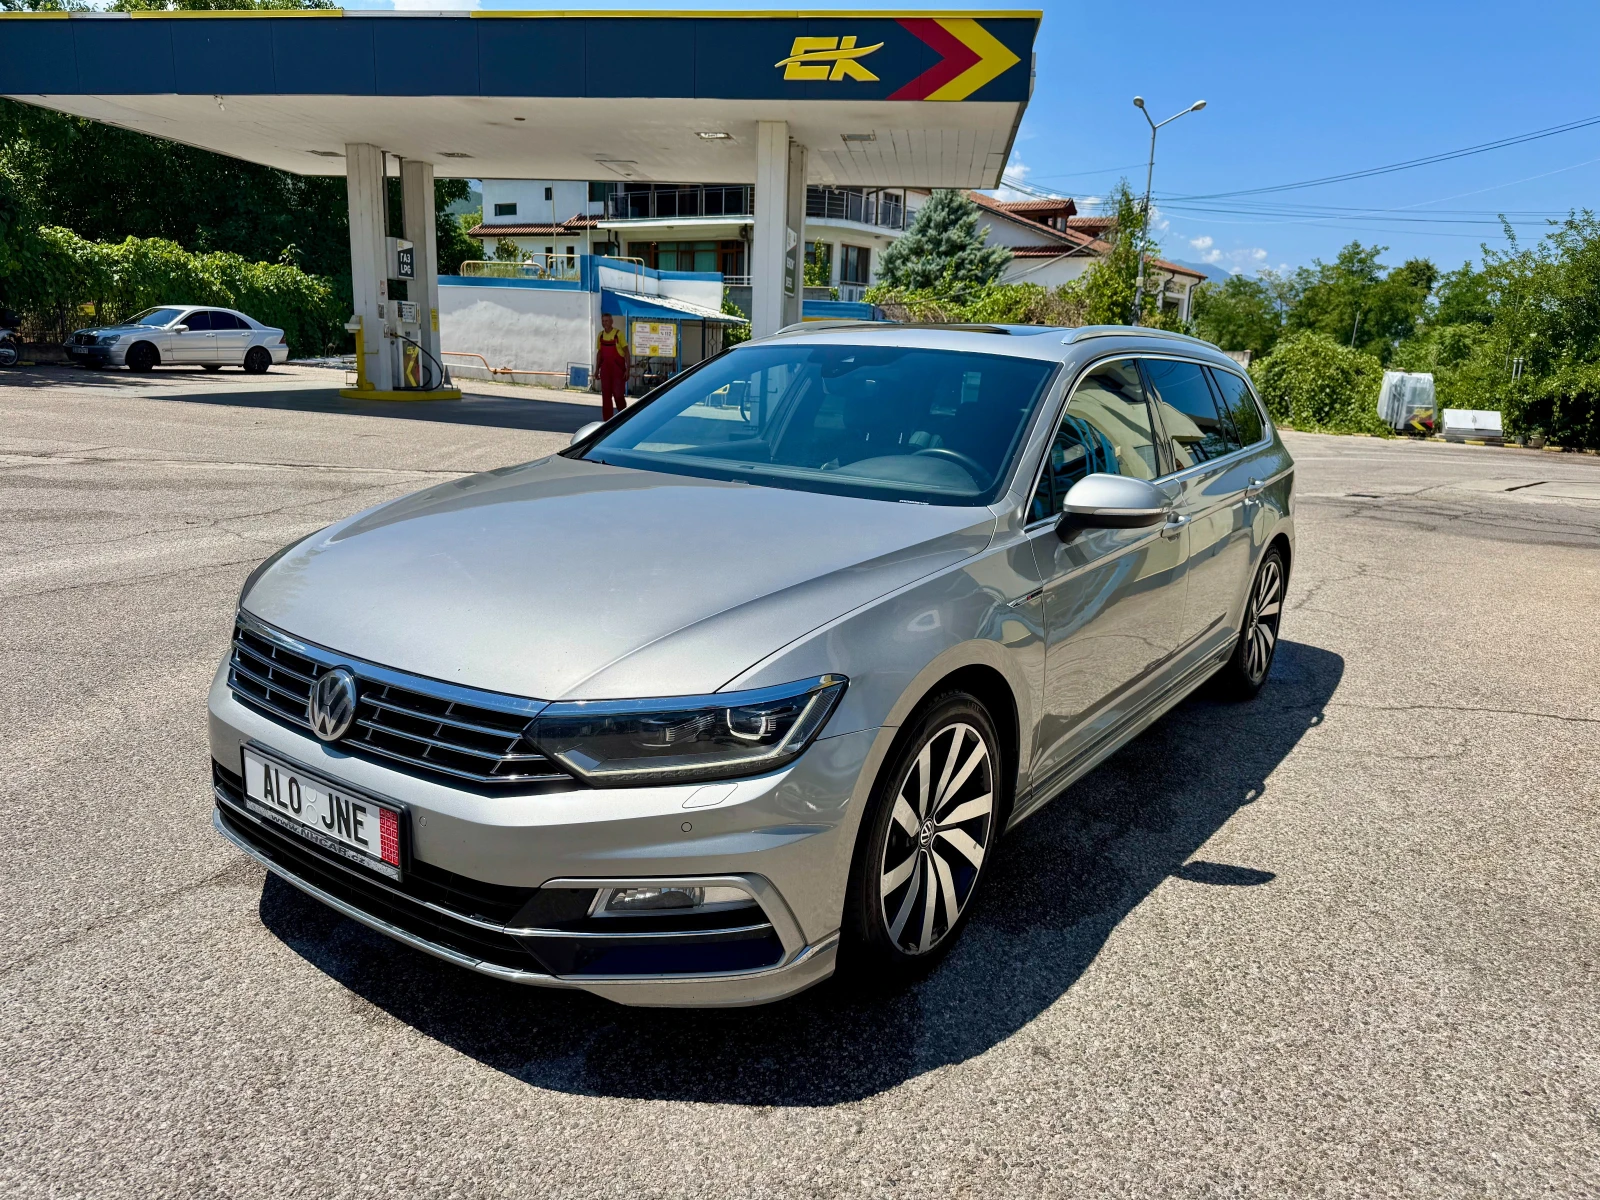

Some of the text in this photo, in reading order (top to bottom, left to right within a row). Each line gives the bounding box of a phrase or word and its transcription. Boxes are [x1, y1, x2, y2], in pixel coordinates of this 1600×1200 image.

[778, 36, 883, 81] EK
[400, 253, 410, 263] ГАЗ
[400, 264, 411, 274] LPG
[264, 763, 302, 814] ALO
[321, 793, 369, 846] JNE
